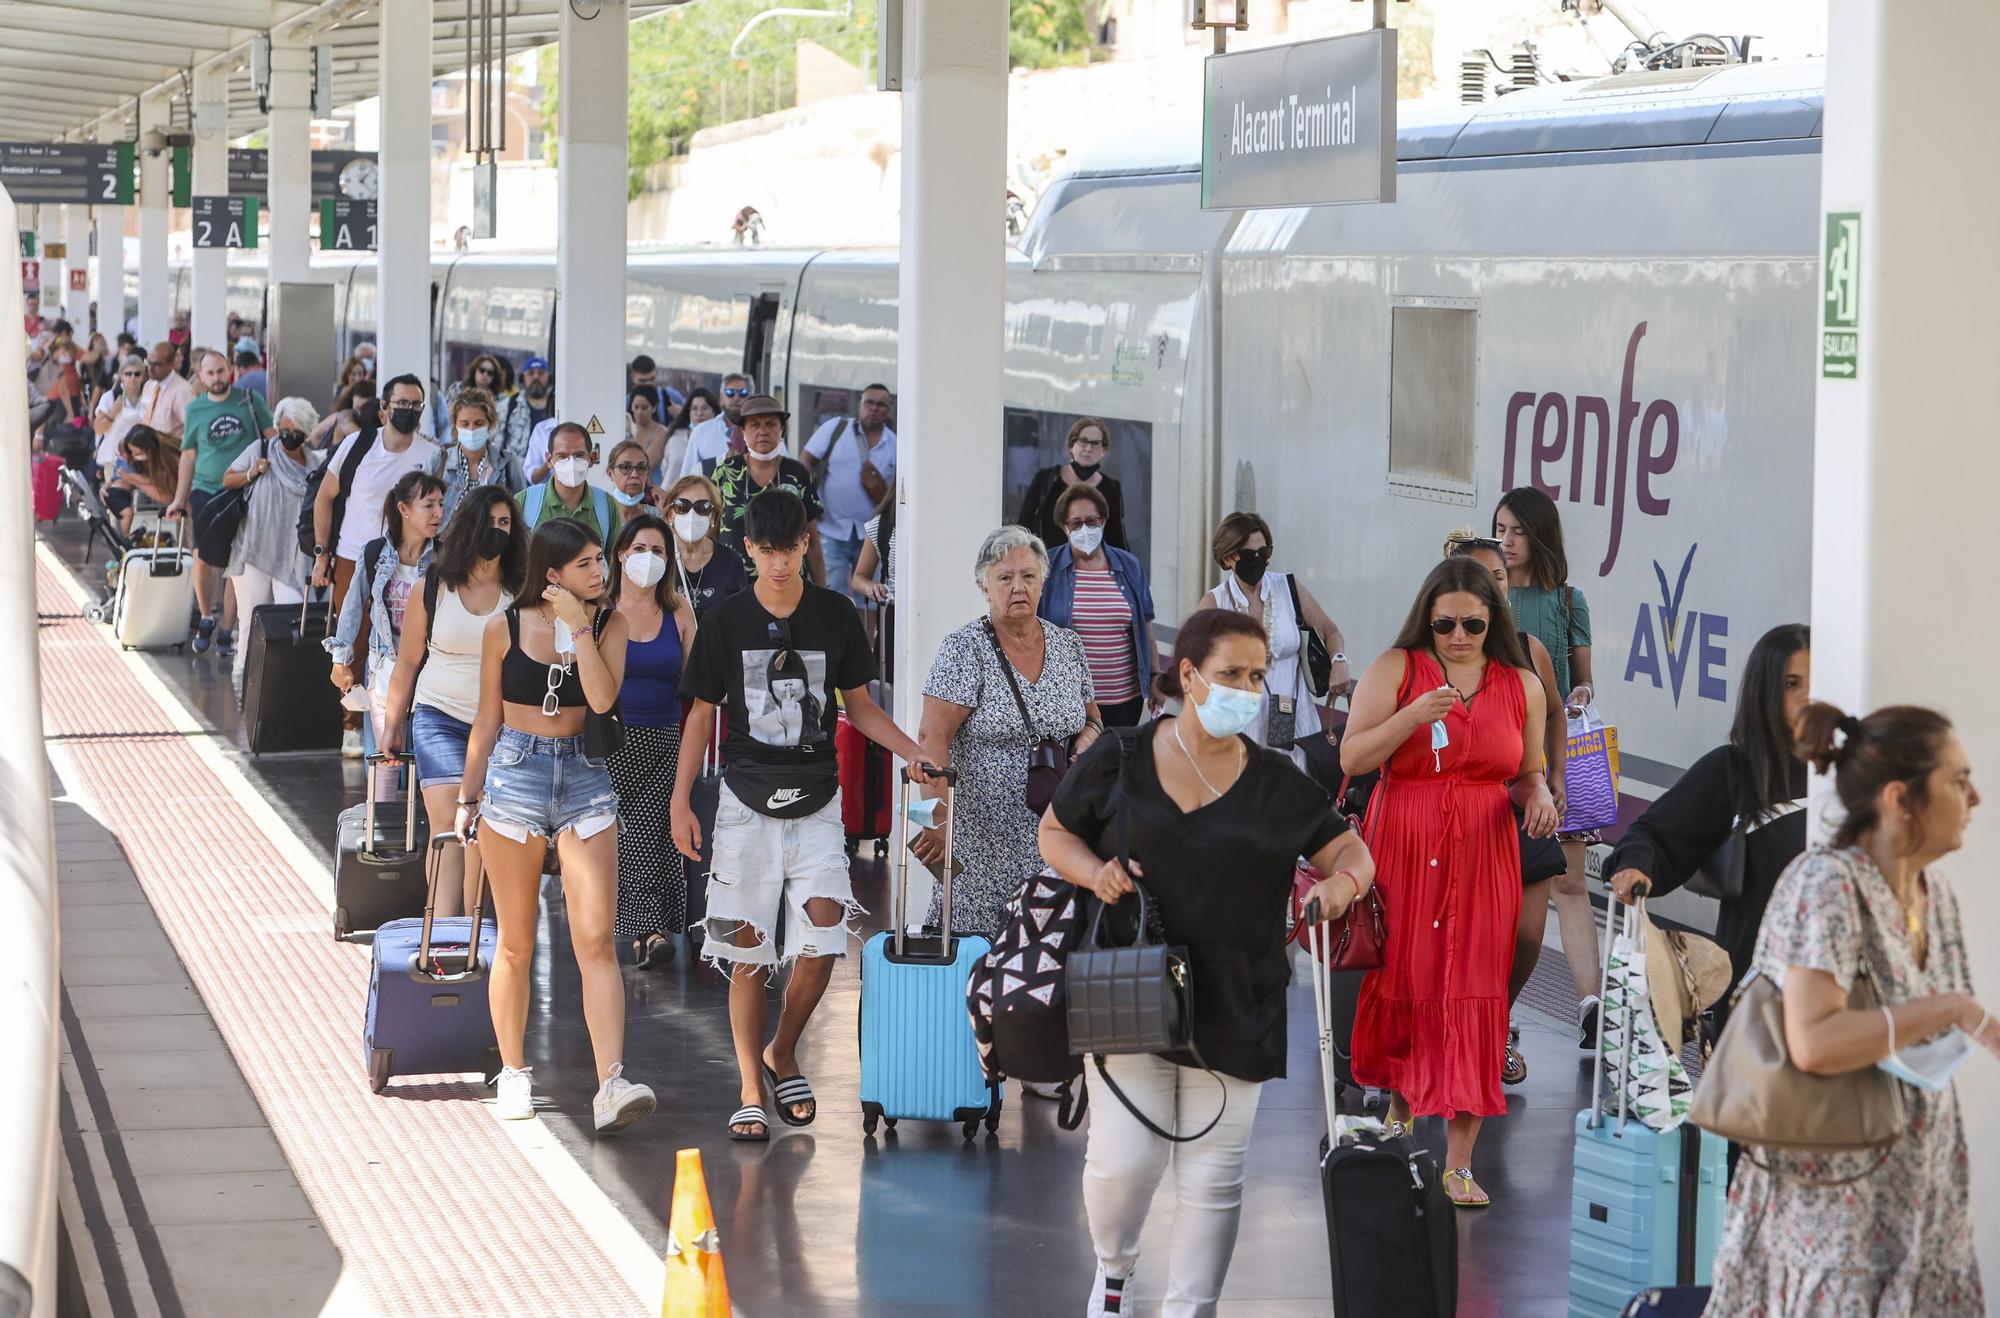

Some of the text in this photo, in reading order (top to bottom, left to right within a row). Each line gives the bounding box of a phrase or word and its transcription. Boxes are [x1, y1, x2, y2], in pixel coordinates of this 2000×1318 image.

[1231, 85, 1356, 156] Alacant Terminal
[102, 174, 117, 199] 2
[197, 220, 242, 247] 2 A
[335, 223, 377, 249] A 1
[1502, 321, 1679, 577] renfe
[1624, 543, 1728, 710] AVE
[773, 788, 801, 801] NIKE
